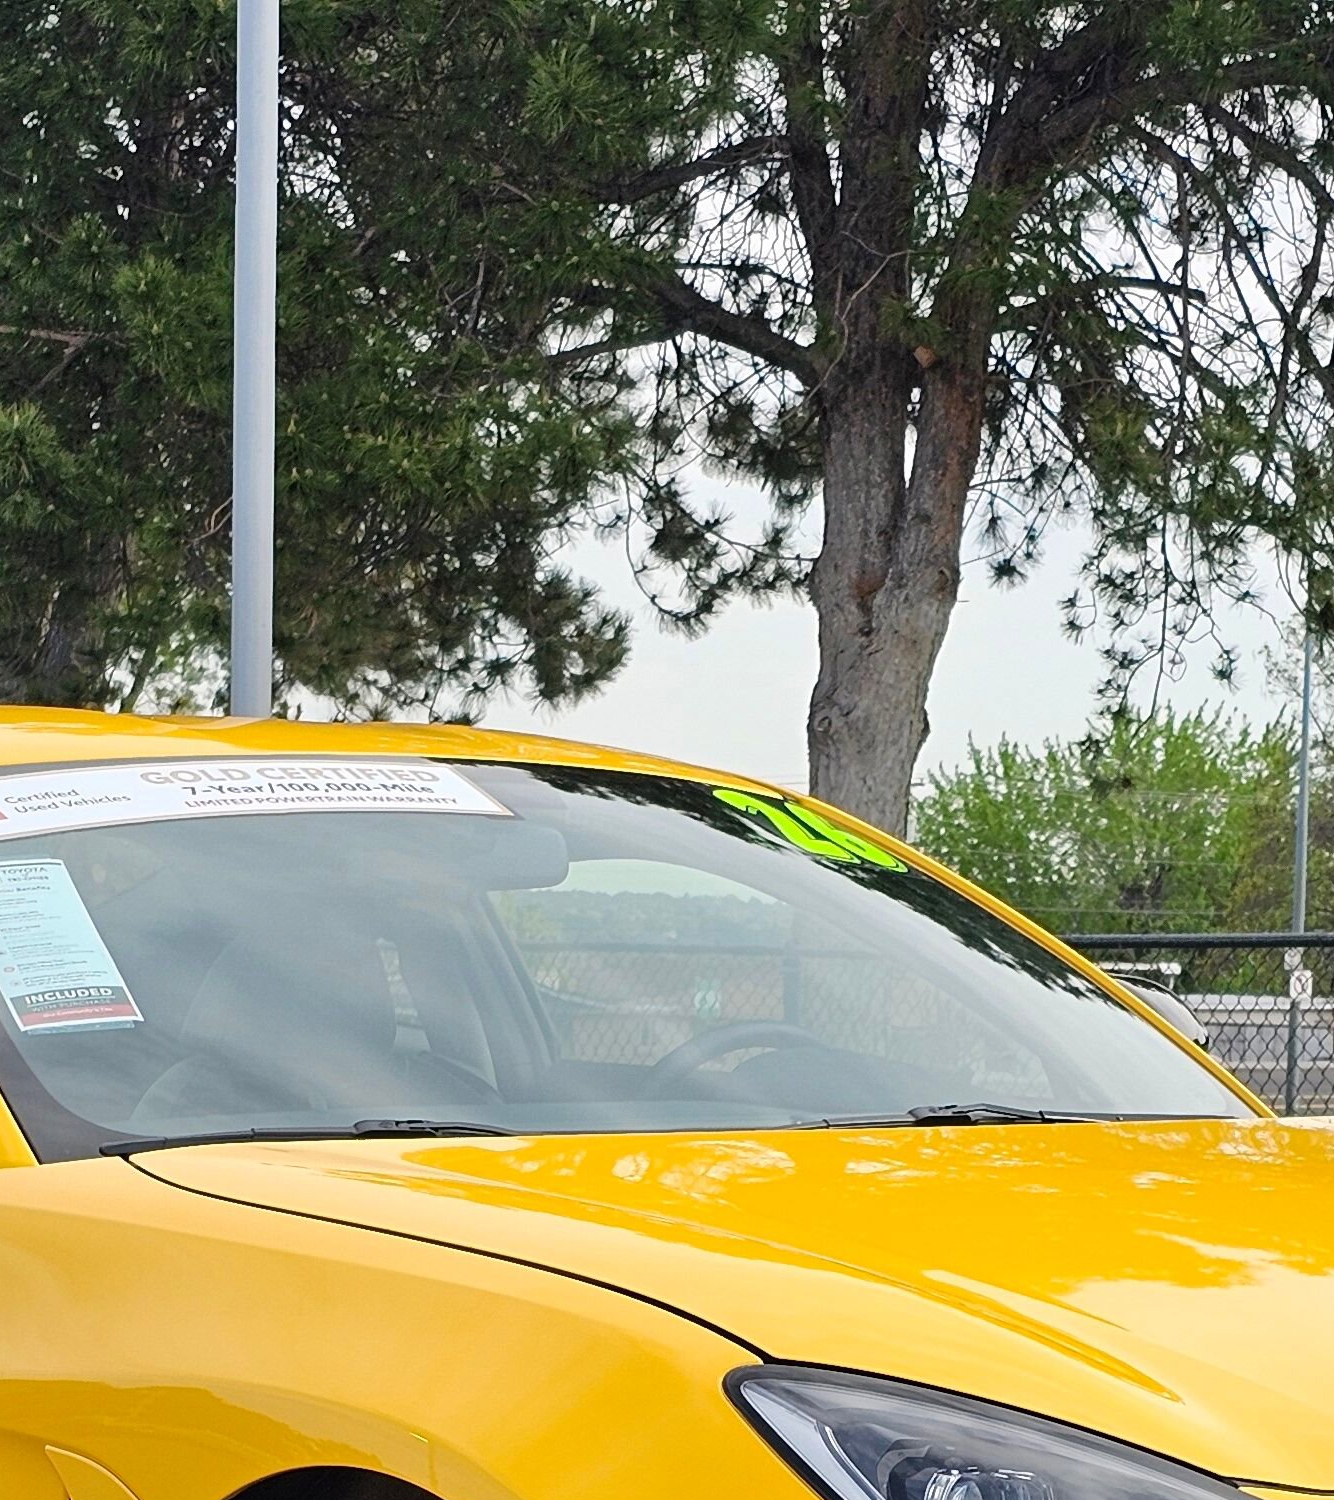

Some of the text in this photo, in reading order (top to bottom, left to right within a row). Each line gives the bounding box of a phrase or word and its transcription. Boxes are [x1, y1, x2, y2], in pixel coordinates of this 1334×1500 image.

[139, 767, 440, 785] GOLD CERTIFIED
[4, 789, 80, 804] Certified
[14, 793, 132, 813] Used Vehicles
[184, 795, 458, 808] LIMITED POWERTRAIN WARRANTY
[0, 866, 48, 875] TOYOTA
[24, 987, 113, 1005] INCLUDED
[32, 1003, 57, 1013] WITH
